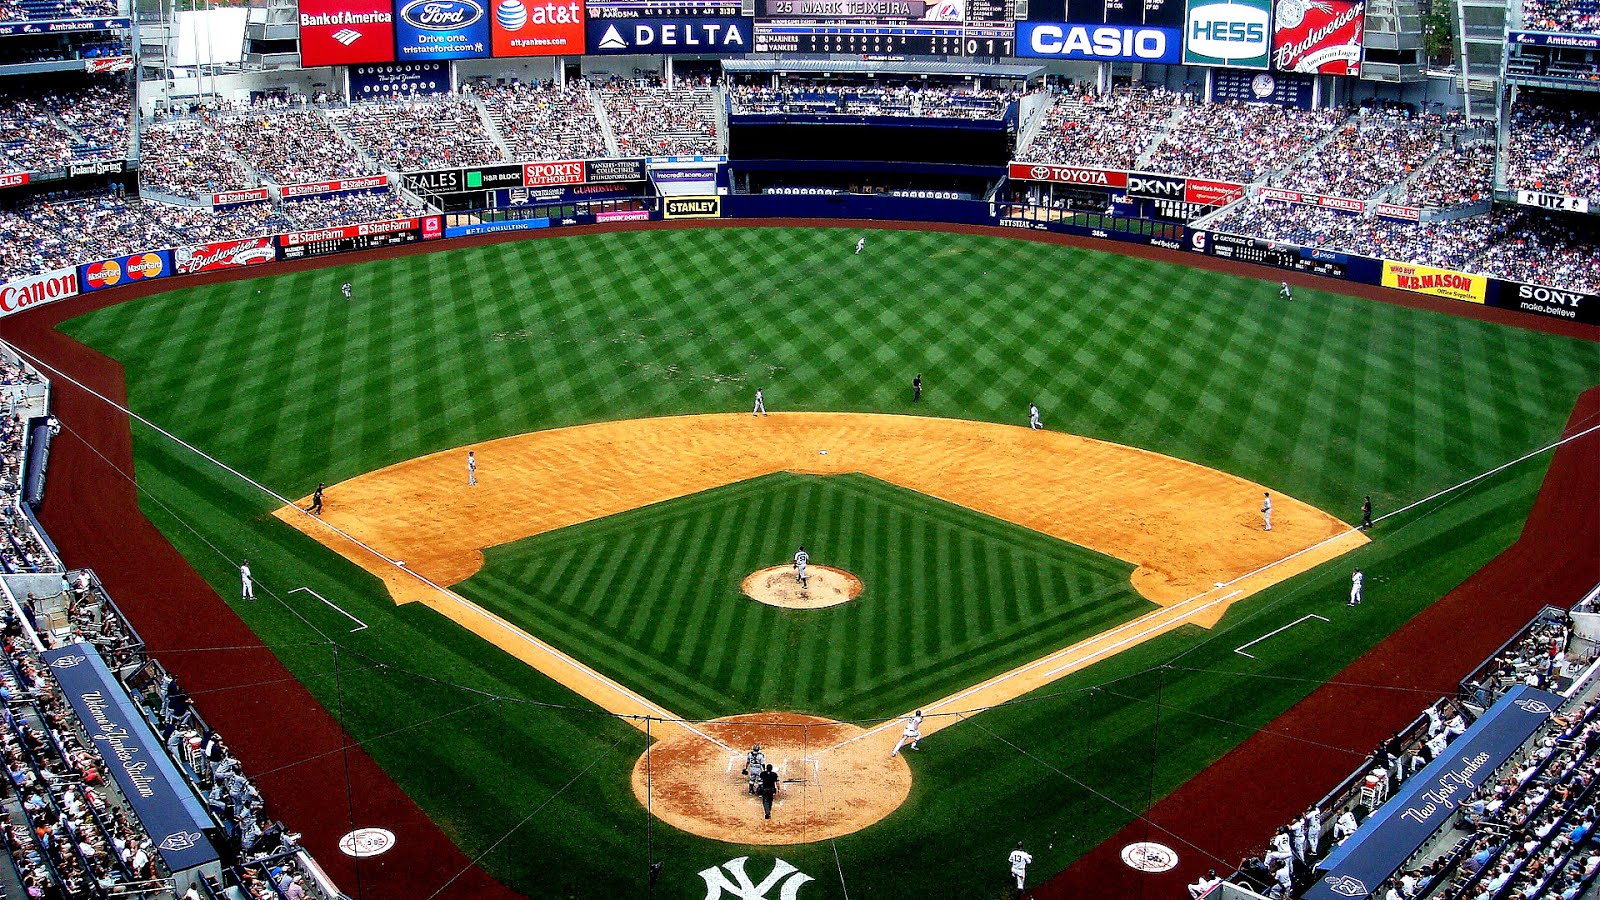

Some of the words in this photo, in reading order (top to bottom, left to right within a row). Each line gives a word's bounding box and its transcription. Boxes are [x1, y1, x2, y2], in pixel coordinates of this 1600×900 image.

[420, 3, 464, 24] Ford
[532, 2, 580, 24] at&t
[776, 2, 793, 12] 25
[802, 2, 842, 14] MARK
[846, 1, 910, 14] TEIXEIRA
[300, 12, 330, 26] Bank
[330, 11, 343, 25] of
[344, 10, 392, 24] America
[49, 22, 94, 31] Amtrak.com
[1192, 20, 1263, 43] HESS
[418, 34, 444, 43] Drive
[446, 34, 468, 42] one.
[636, 24, 744, 45] DELTA
[811, 35, 816, 43] 0
[887, 36, 892, 44] 0
[1031, 25, 1166, 58] CASIO
[1273, 2, 1364, 70] Budweiser
[1546, 36, 1597, 47] Amtrak.com
[404, 44, 474, 54] tristateford.com
[510, 38, 566, 47] att.yankees.com
[967, 39, 978, 54] 0
[986, 40, 994, 54] 1
[1004, 40, 1011, 54] 1
[70, 165, 96, 177] Poland
[96, 162, 123, 174] Spring
[527, 163, 581, 177] SPORTS
[1052, 168, 1108, 184] TOYOTA
[365, 178, 380, 186] Farm
[410, 172, 457, 189] ZALES
[483, 174, 498, 182] H&R
[528, 174, 582, 184] AUTHORITY.
[296, 186, 314, 195] State
[1129, 177, 1186, 196] DKNY
[245, 192, 261, 200] Farm
[1112, 194, 1133, 204] FedEx
[1538, 194, 1564, 208] UTZ
[669, 202, 714, 212] STANLEY
[1154, 200, 1200, 212] SHARPER
[1322, 198, 1360, 210] MODELL'S
[1378, 205, 1418, 217] MODELL'S
[300, 232, 321, 242] State
[322, 229, 344, 239] Farm
[369, 223, 391, 234] State
[390, 221, 411, 231] Farm
[487, 224, 528, 232] CONSULTING
[1192, 231, 1206, 248] G
[186, 239, 259, 274] Budweiser
[1320, 252, 1336, 260] pepsi
[88, 268, 121, 281] MasterCard
[128, 261, 162, 273] MasterCard
[1390, 265, 1403, 274] WHO
[1403, 267, 1415, 275] BUT
[0, 273, 77, 312] Canon
[1437, 288, 1453, 296] Office
[1453, 291, 1477, 300] Supplies
[1519, 285, 1584, 307] SONY
[1520, 300, 1576, 318] make.believe
[81, 690, 109, 724] Welcome
[100, 722, 118, 732] to
[94, 728, 139, 761] Yankee
[123, 761, 155, 798] Stadium
[1400, 804, 1436, 824] New
[1422, 778, 1458, 809] York
[1444, 751, 1490, 788] Yankees
[1014, 854, 1022, 862] 13
[1339, 879, 1360, 894] 27
